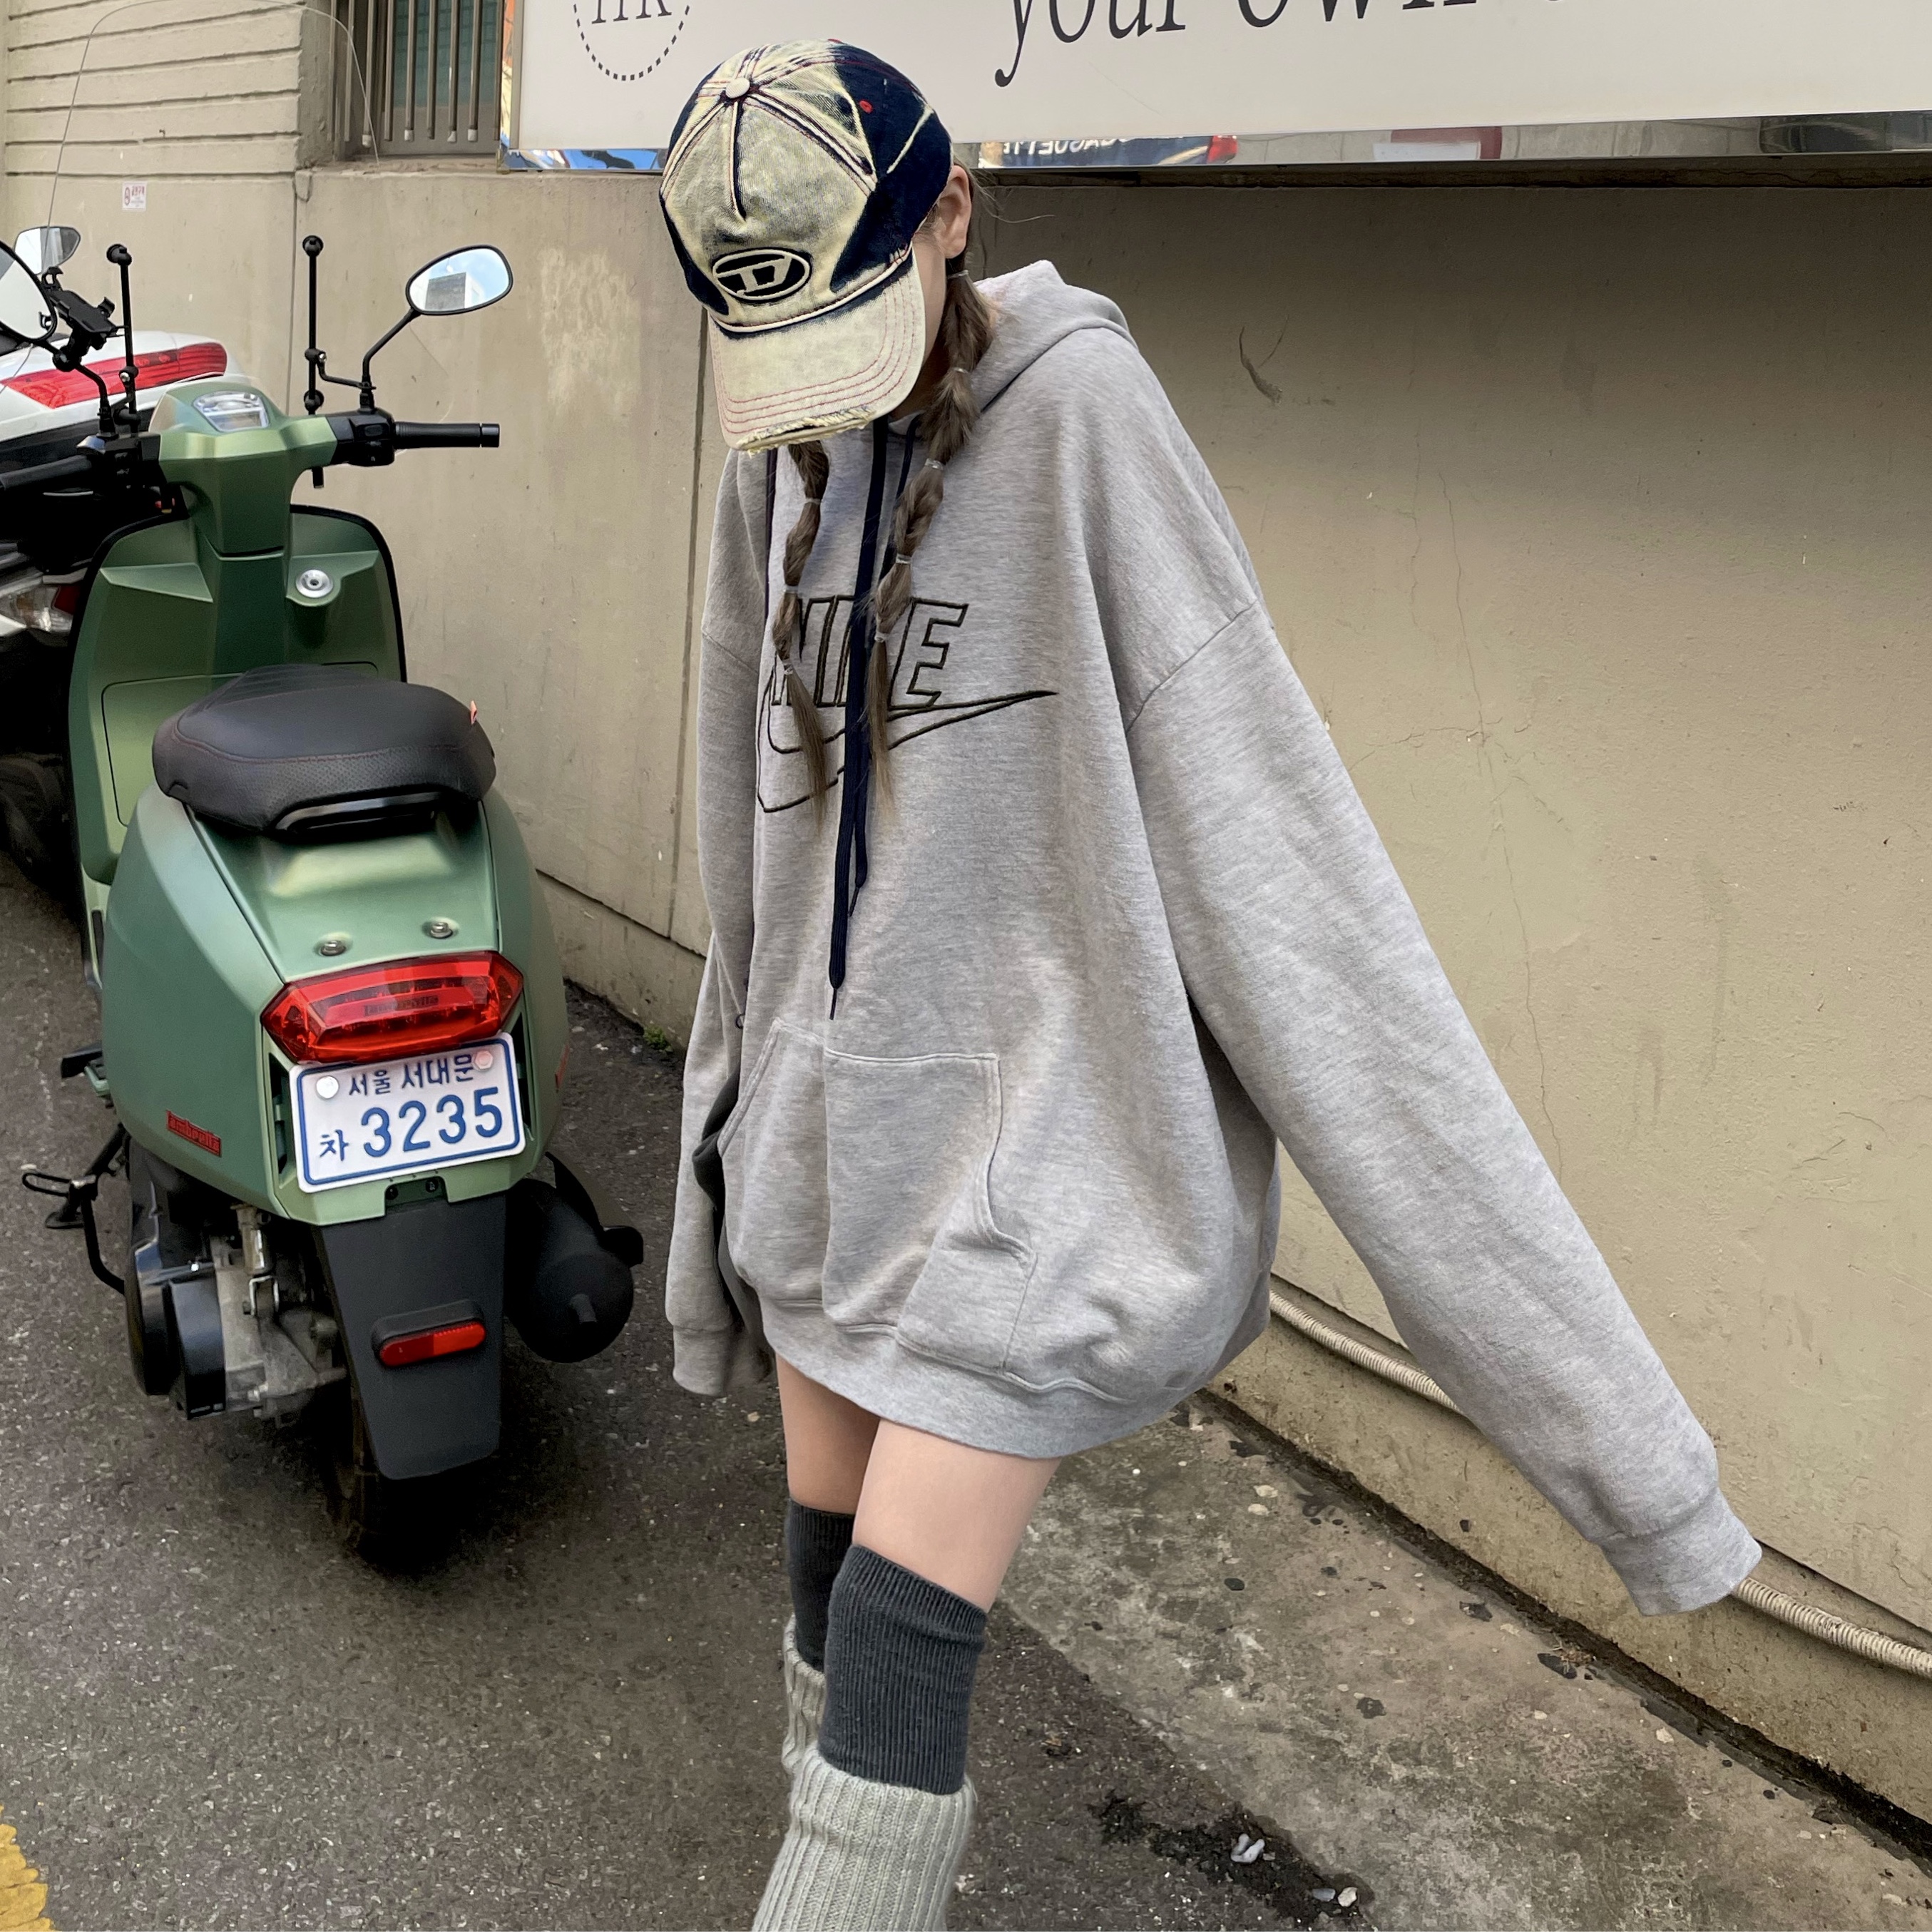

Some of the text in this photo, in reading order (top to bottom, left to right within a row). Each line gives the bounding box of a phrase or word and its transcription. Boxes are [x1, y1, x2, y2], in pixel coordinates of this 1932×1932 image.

[771, 595, 969, 710] NIE
[348, 1053, 474, 1096] 서울 서대문
[320, 1086, 503, 1161] 차 3235
